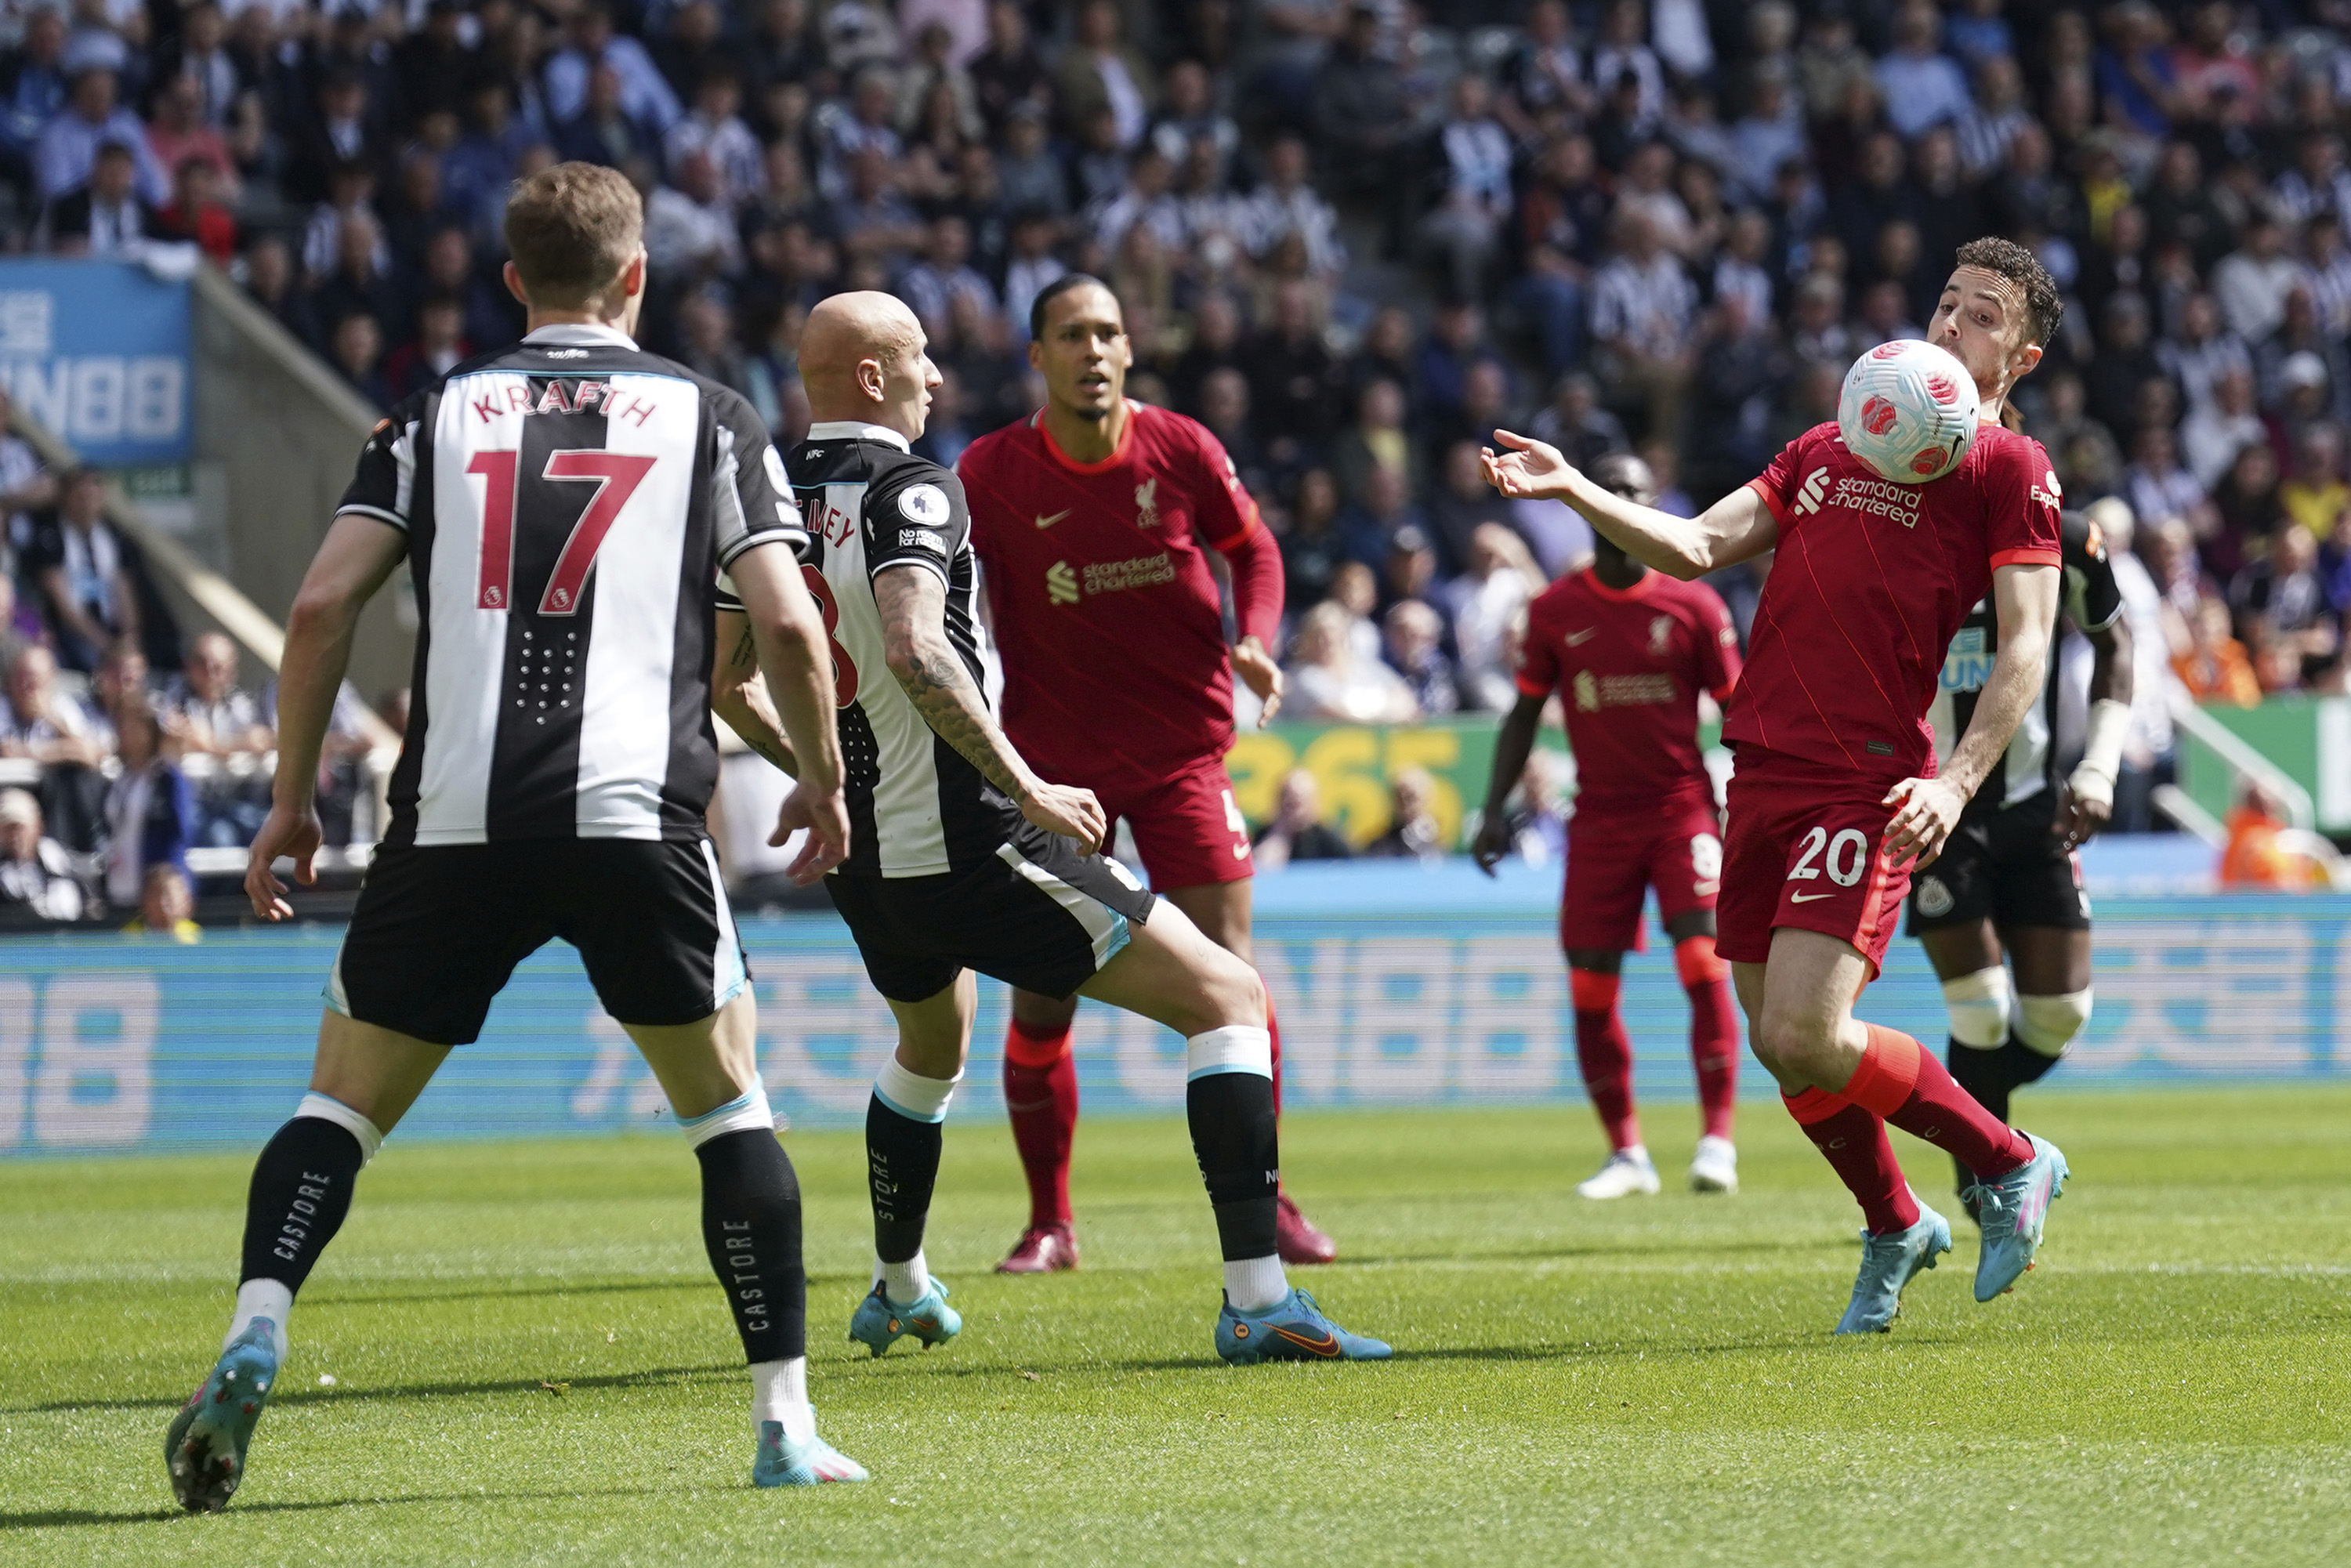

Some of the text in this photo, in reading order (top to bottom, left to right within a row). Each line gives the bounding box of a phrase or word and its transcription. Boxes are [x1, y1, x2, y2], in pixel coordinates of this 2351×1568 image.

[0, 356, 183, 437] N88
[472, 378, 657, 427] KRAFTH
[1828, 491, 1919, 529] chartered
[1835, 476, 1922, 509] standard
[464, 448, 658, 617] 17
[899, 528, 915, 538] No
[1082, 550, 1168, 578] standard
[1085, 564, 1176, 596] chartered
[1787, 826, 1867, 887] 20
[273, 1171, 331, 1262] CASTORE
[722, 1220, 770, 1332] CASTORE
